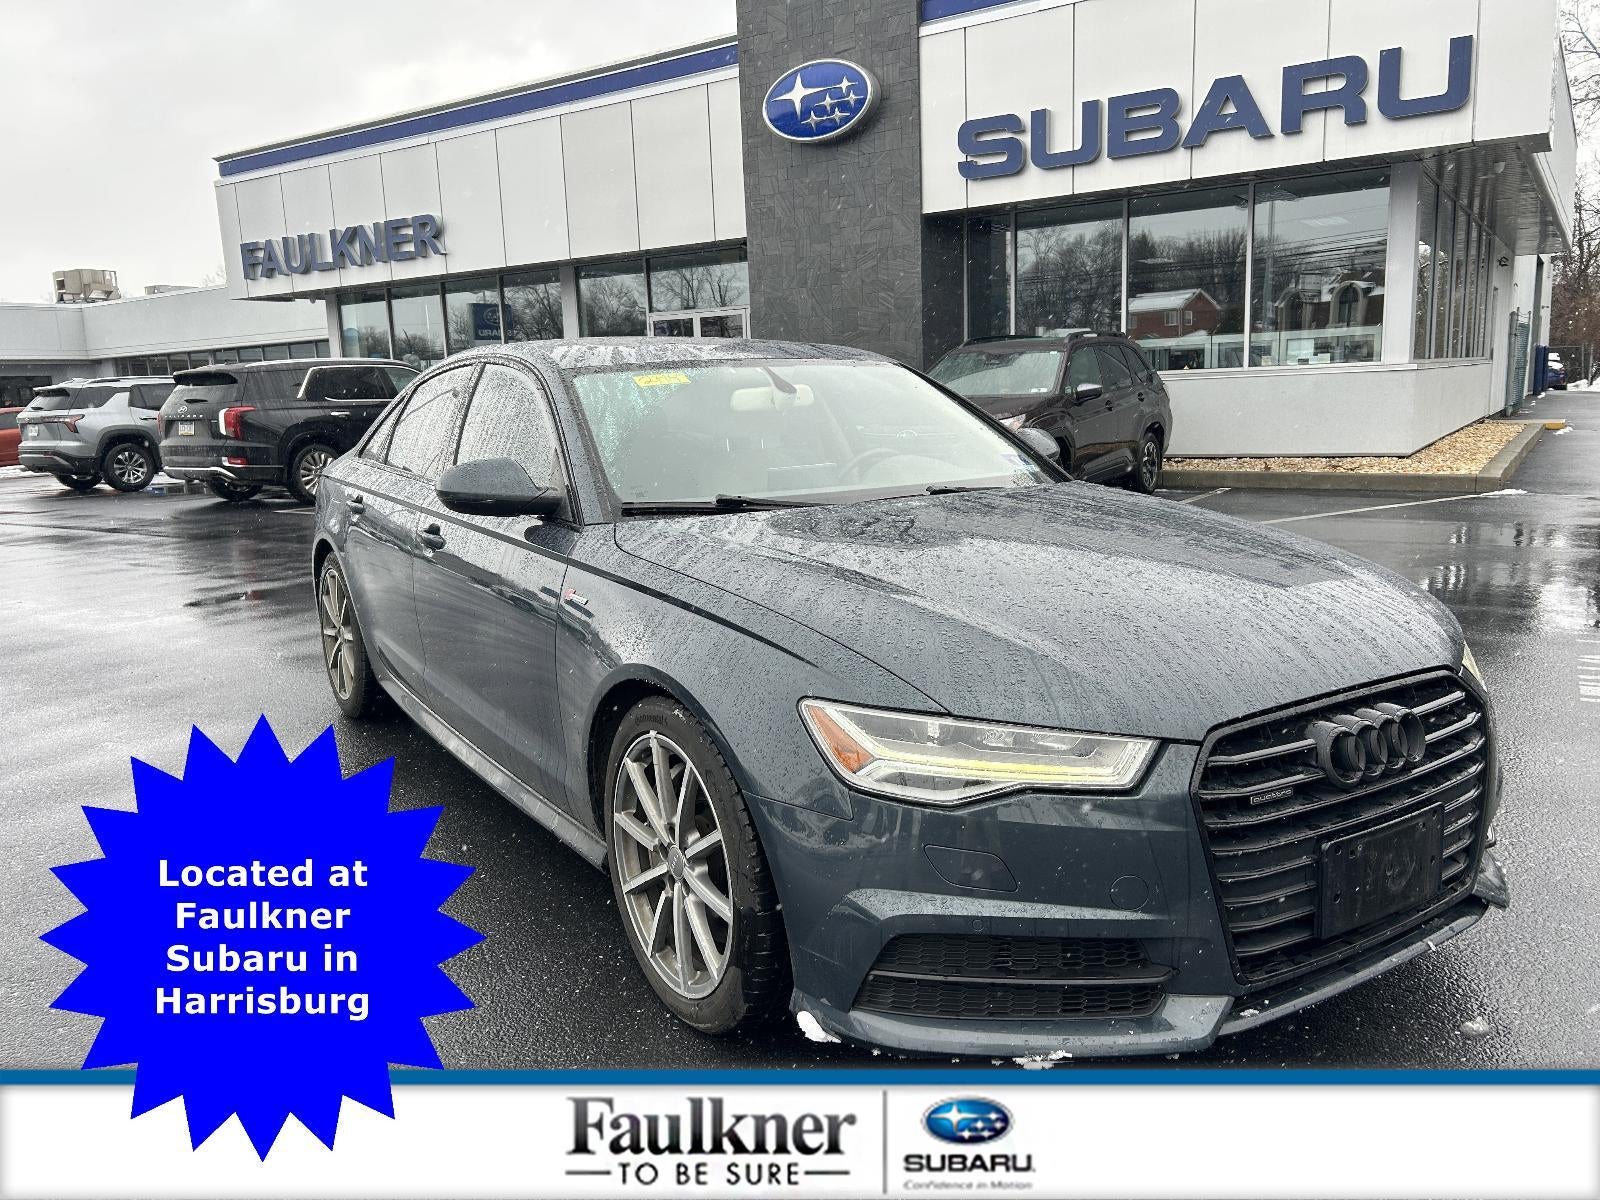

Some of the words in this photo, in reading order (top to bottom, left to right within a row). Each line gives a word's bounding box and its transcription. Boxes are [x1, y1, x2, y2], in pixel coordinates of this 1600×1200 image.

[958, 35, 1473, 180] SUBARU
[240, 214, 447, 280] FAULKNER
[1253, 789, 1292, 803] quattro
